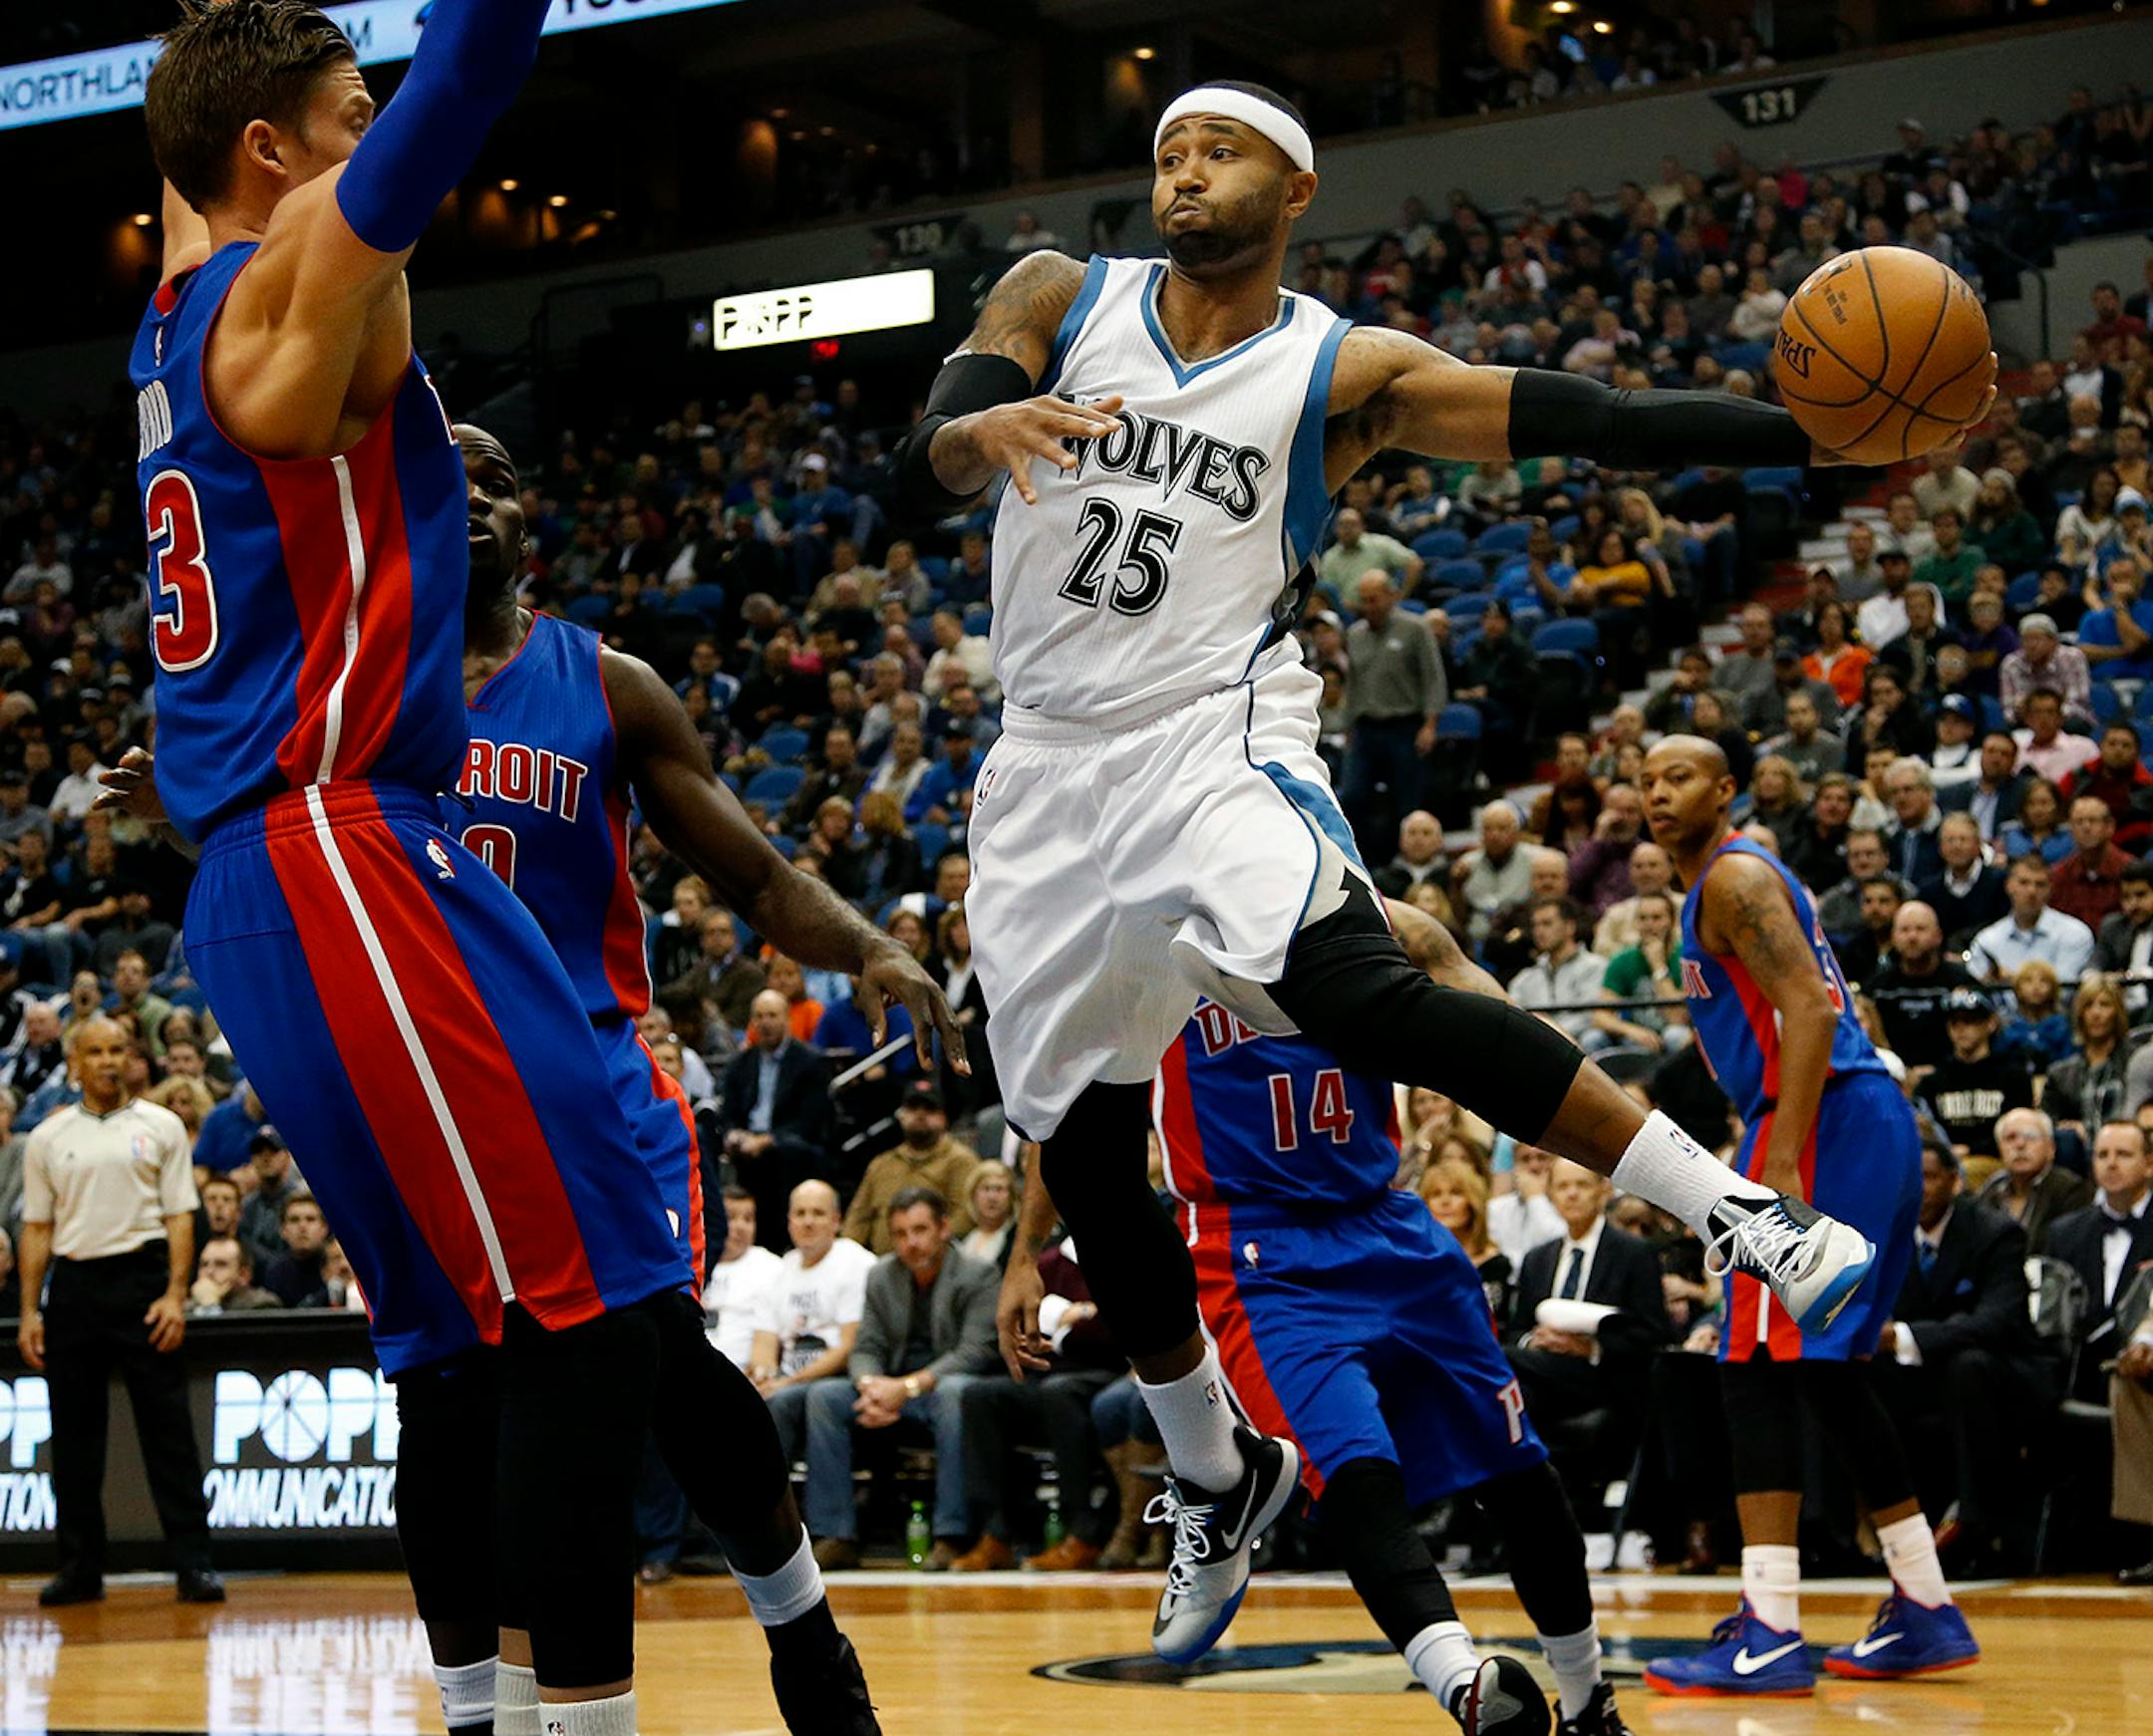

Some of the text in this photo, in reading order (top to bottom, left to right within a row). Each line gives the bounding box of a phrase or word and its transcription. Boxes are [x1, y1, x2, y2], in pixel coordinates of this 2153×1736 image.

[0, 55, 154, 111] NORTHLA
[1740, 87, 1796, 123] 131
[1057, 496, 1184, 617] 25
[456, 738, 589, 823] ROIT
[1268, 1067, 1355, 1152] 14
